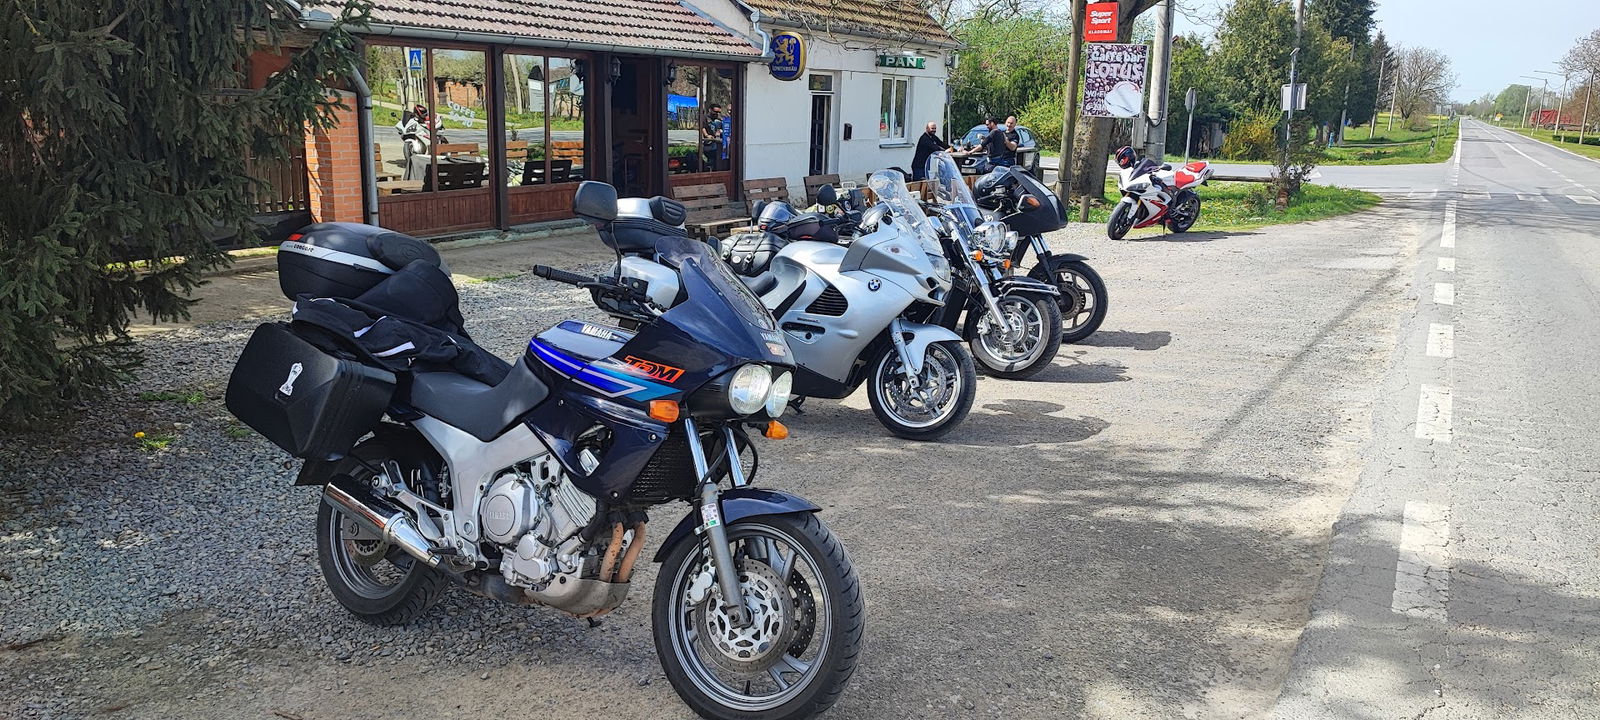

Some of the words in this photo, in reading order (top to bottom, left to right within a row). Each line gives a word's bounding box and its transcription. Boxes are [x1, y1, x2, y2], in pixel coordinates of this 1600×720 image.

[1090, 10, 1113, 18] Super
[1091, 17, 1112, 25] Sport
[886, 56, 917, 67] PAN
[1090, 61, 1143, 80] LOTUS
[581, 323, 613, 340] YAMAHA
[624, 355, 686, 383] TDM
